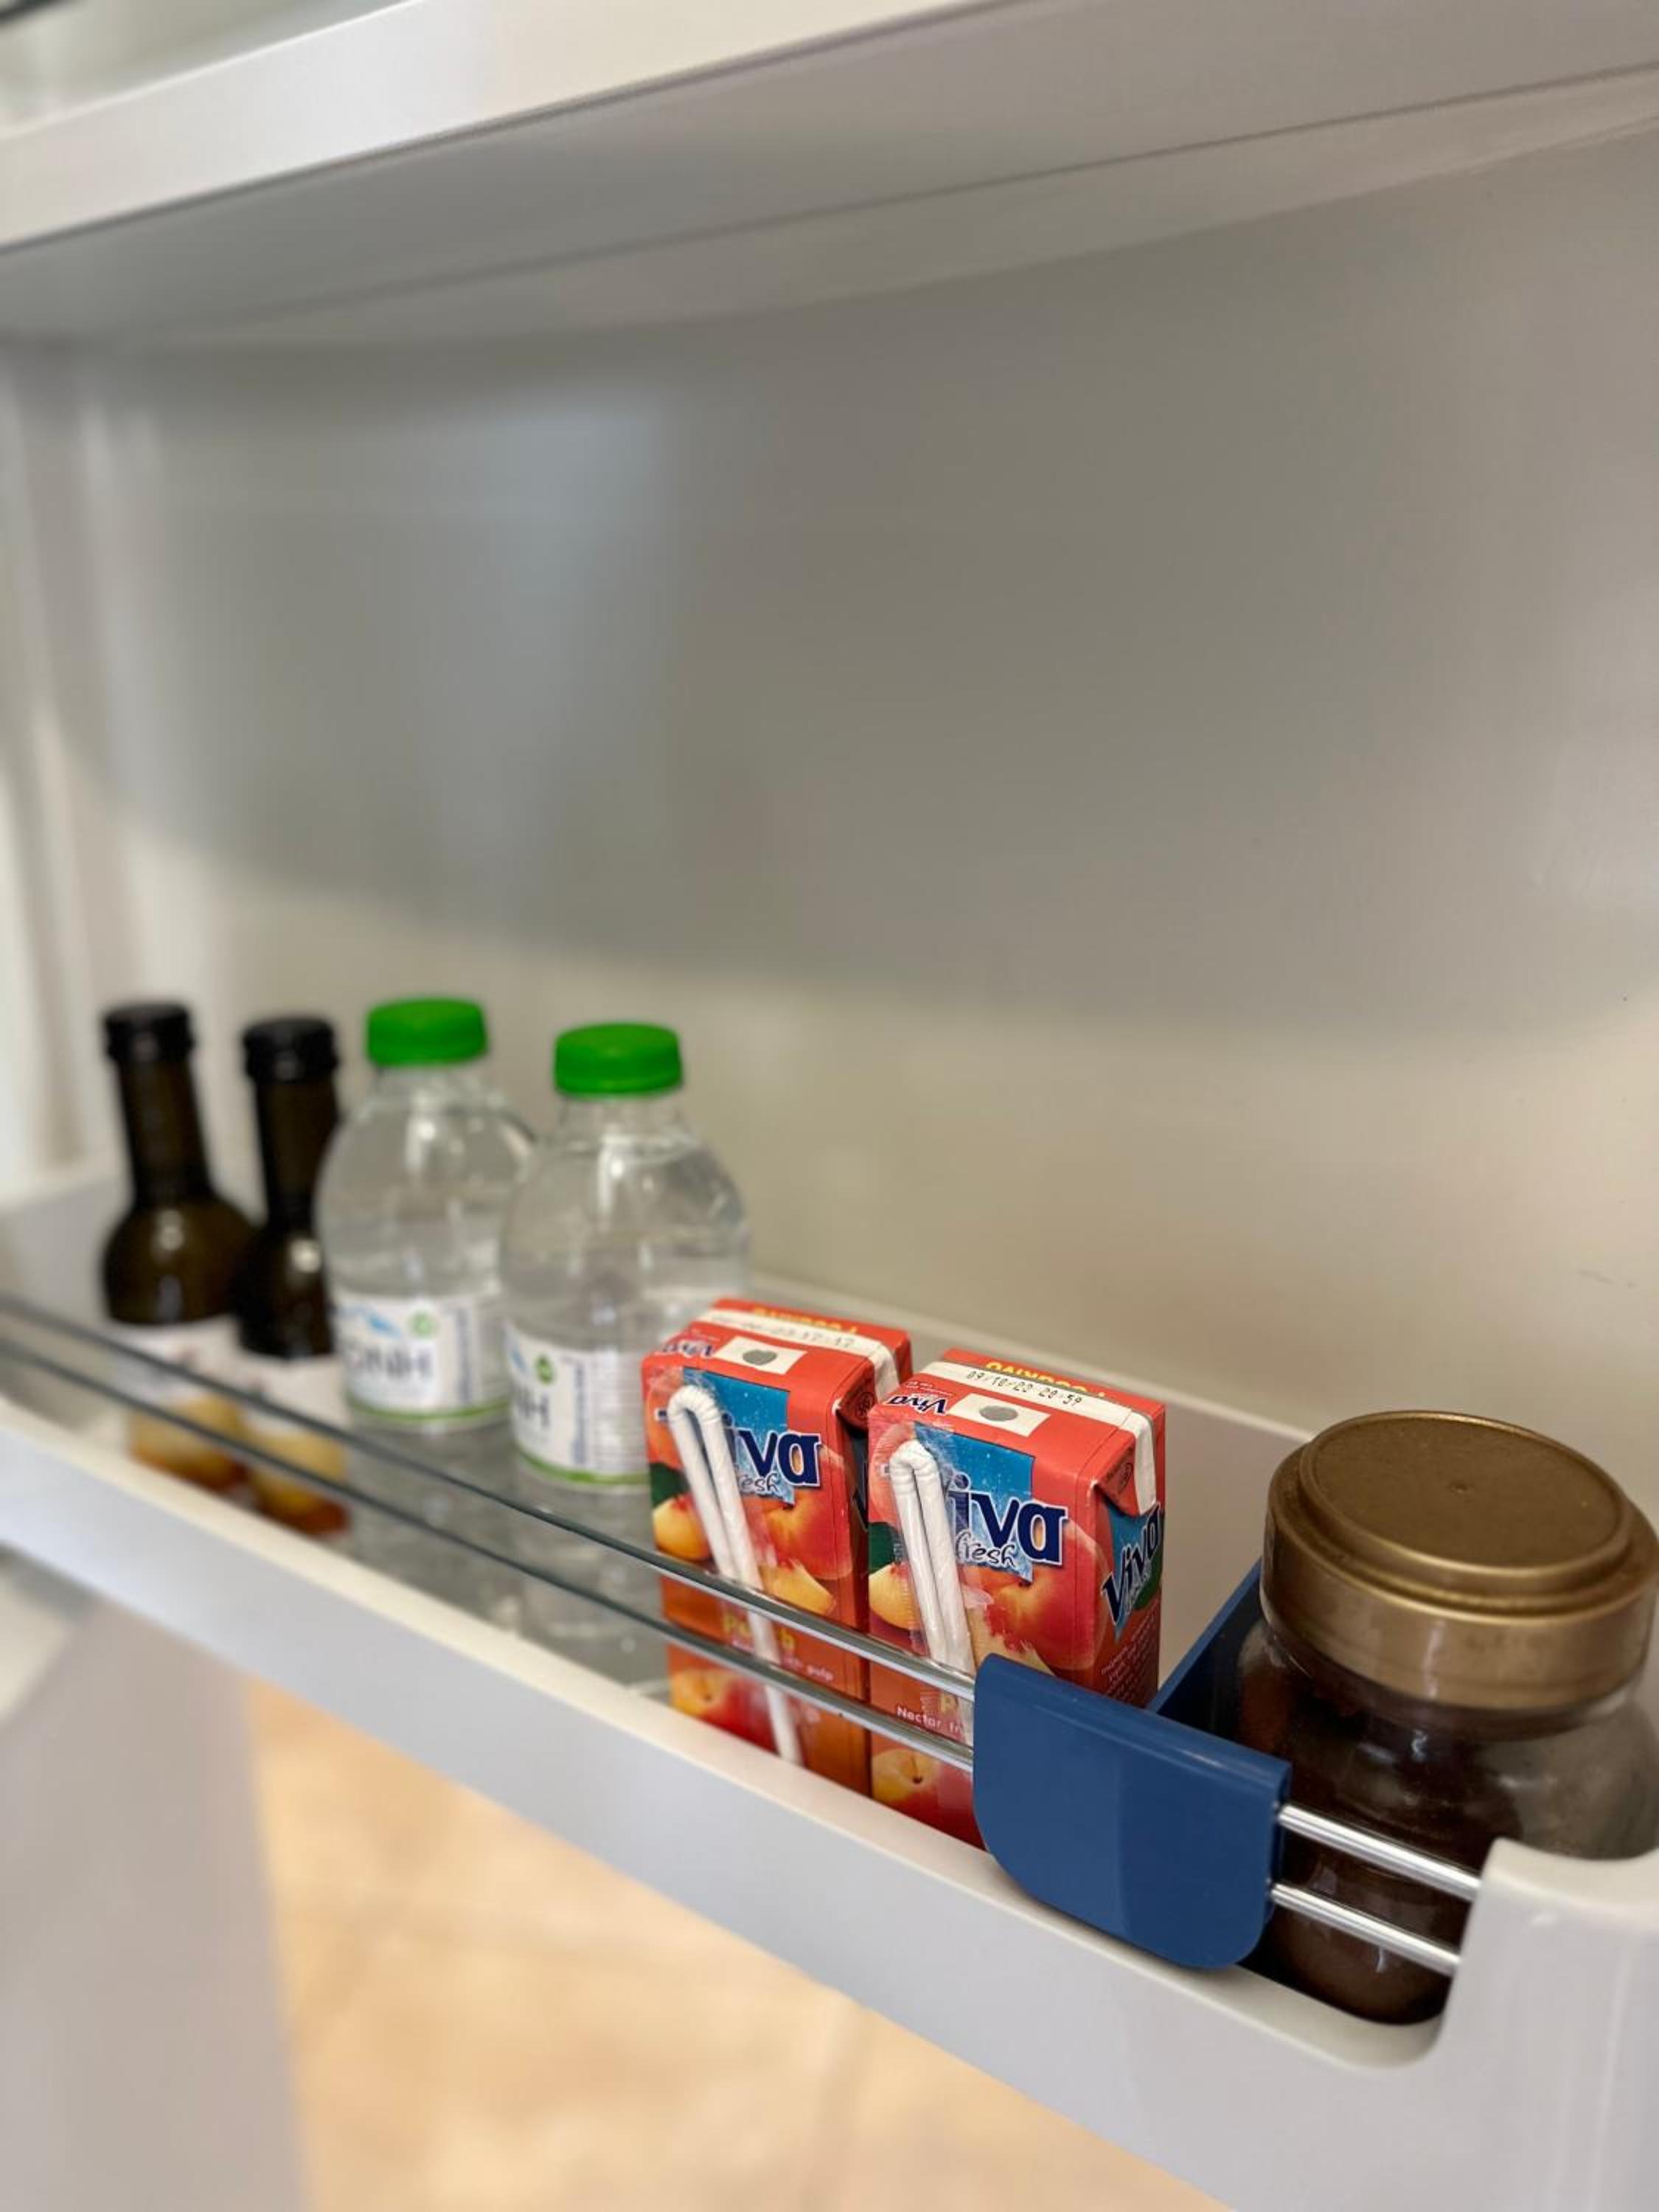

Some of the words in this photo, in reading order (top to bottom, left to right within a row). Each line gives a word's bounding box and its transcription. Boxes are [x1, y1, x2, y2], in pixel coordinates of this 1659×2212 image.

[956, 1530, 1017, 1568] fresh
[1102, 1500, 1161, 1627] Viva
[897, 1705, 942, 1728] Nectar
